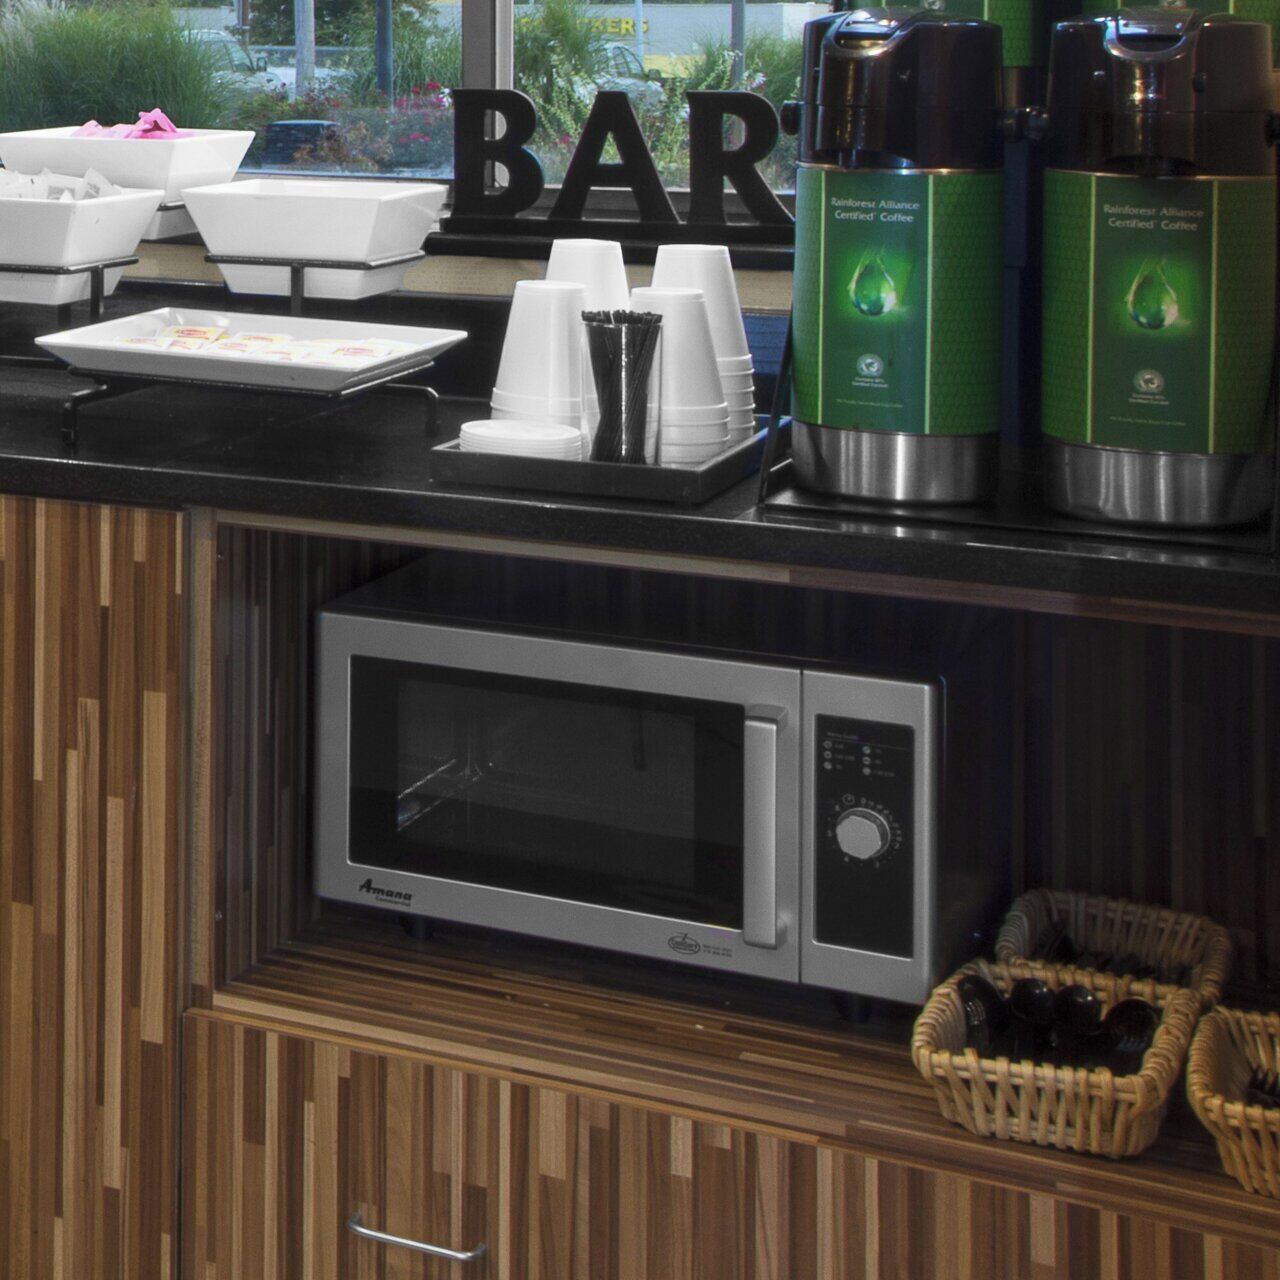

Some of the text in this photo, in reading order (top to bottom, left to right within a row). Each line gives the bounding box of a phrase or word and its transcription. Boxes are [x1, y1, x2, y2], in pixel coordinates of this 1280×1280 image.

[452, 88, 796, 223] BAR
[830, 196, 920, 210] Rainforest Alliance
[1103, 203, 1204, 218] Rainforest Alliance
[834, 210, 915, 224] Certified Coffee
[1107, 216, 1199, 231] Certified Coffee
[358, 878, 413, 901] Amana
